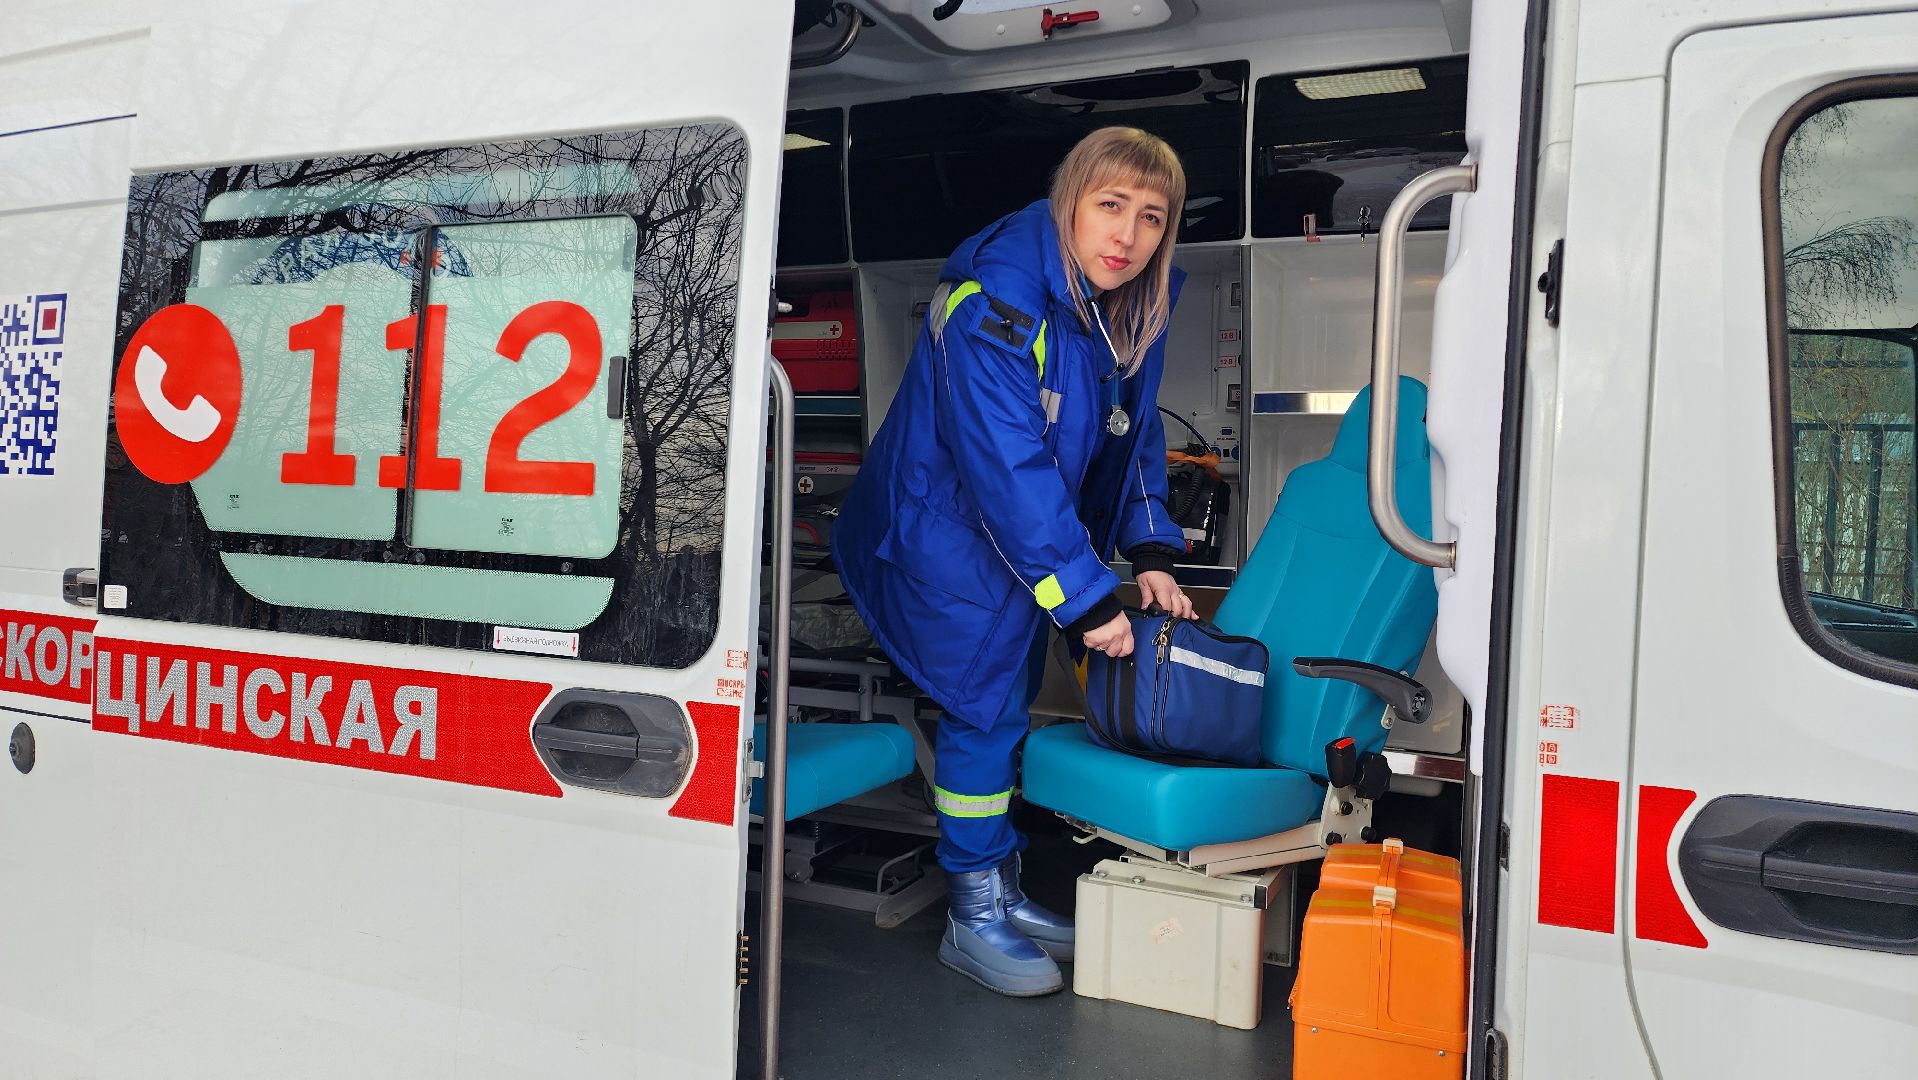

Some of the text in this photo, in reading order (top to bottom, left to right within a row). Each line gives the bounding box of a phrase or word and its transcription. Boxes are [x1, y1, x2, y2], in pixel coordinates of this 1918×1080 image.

[281, 300, 603, 496] 112
[0, 621, 94, 689] КОР
[96, 650, 438, 761] ЦИНСКАЯ
